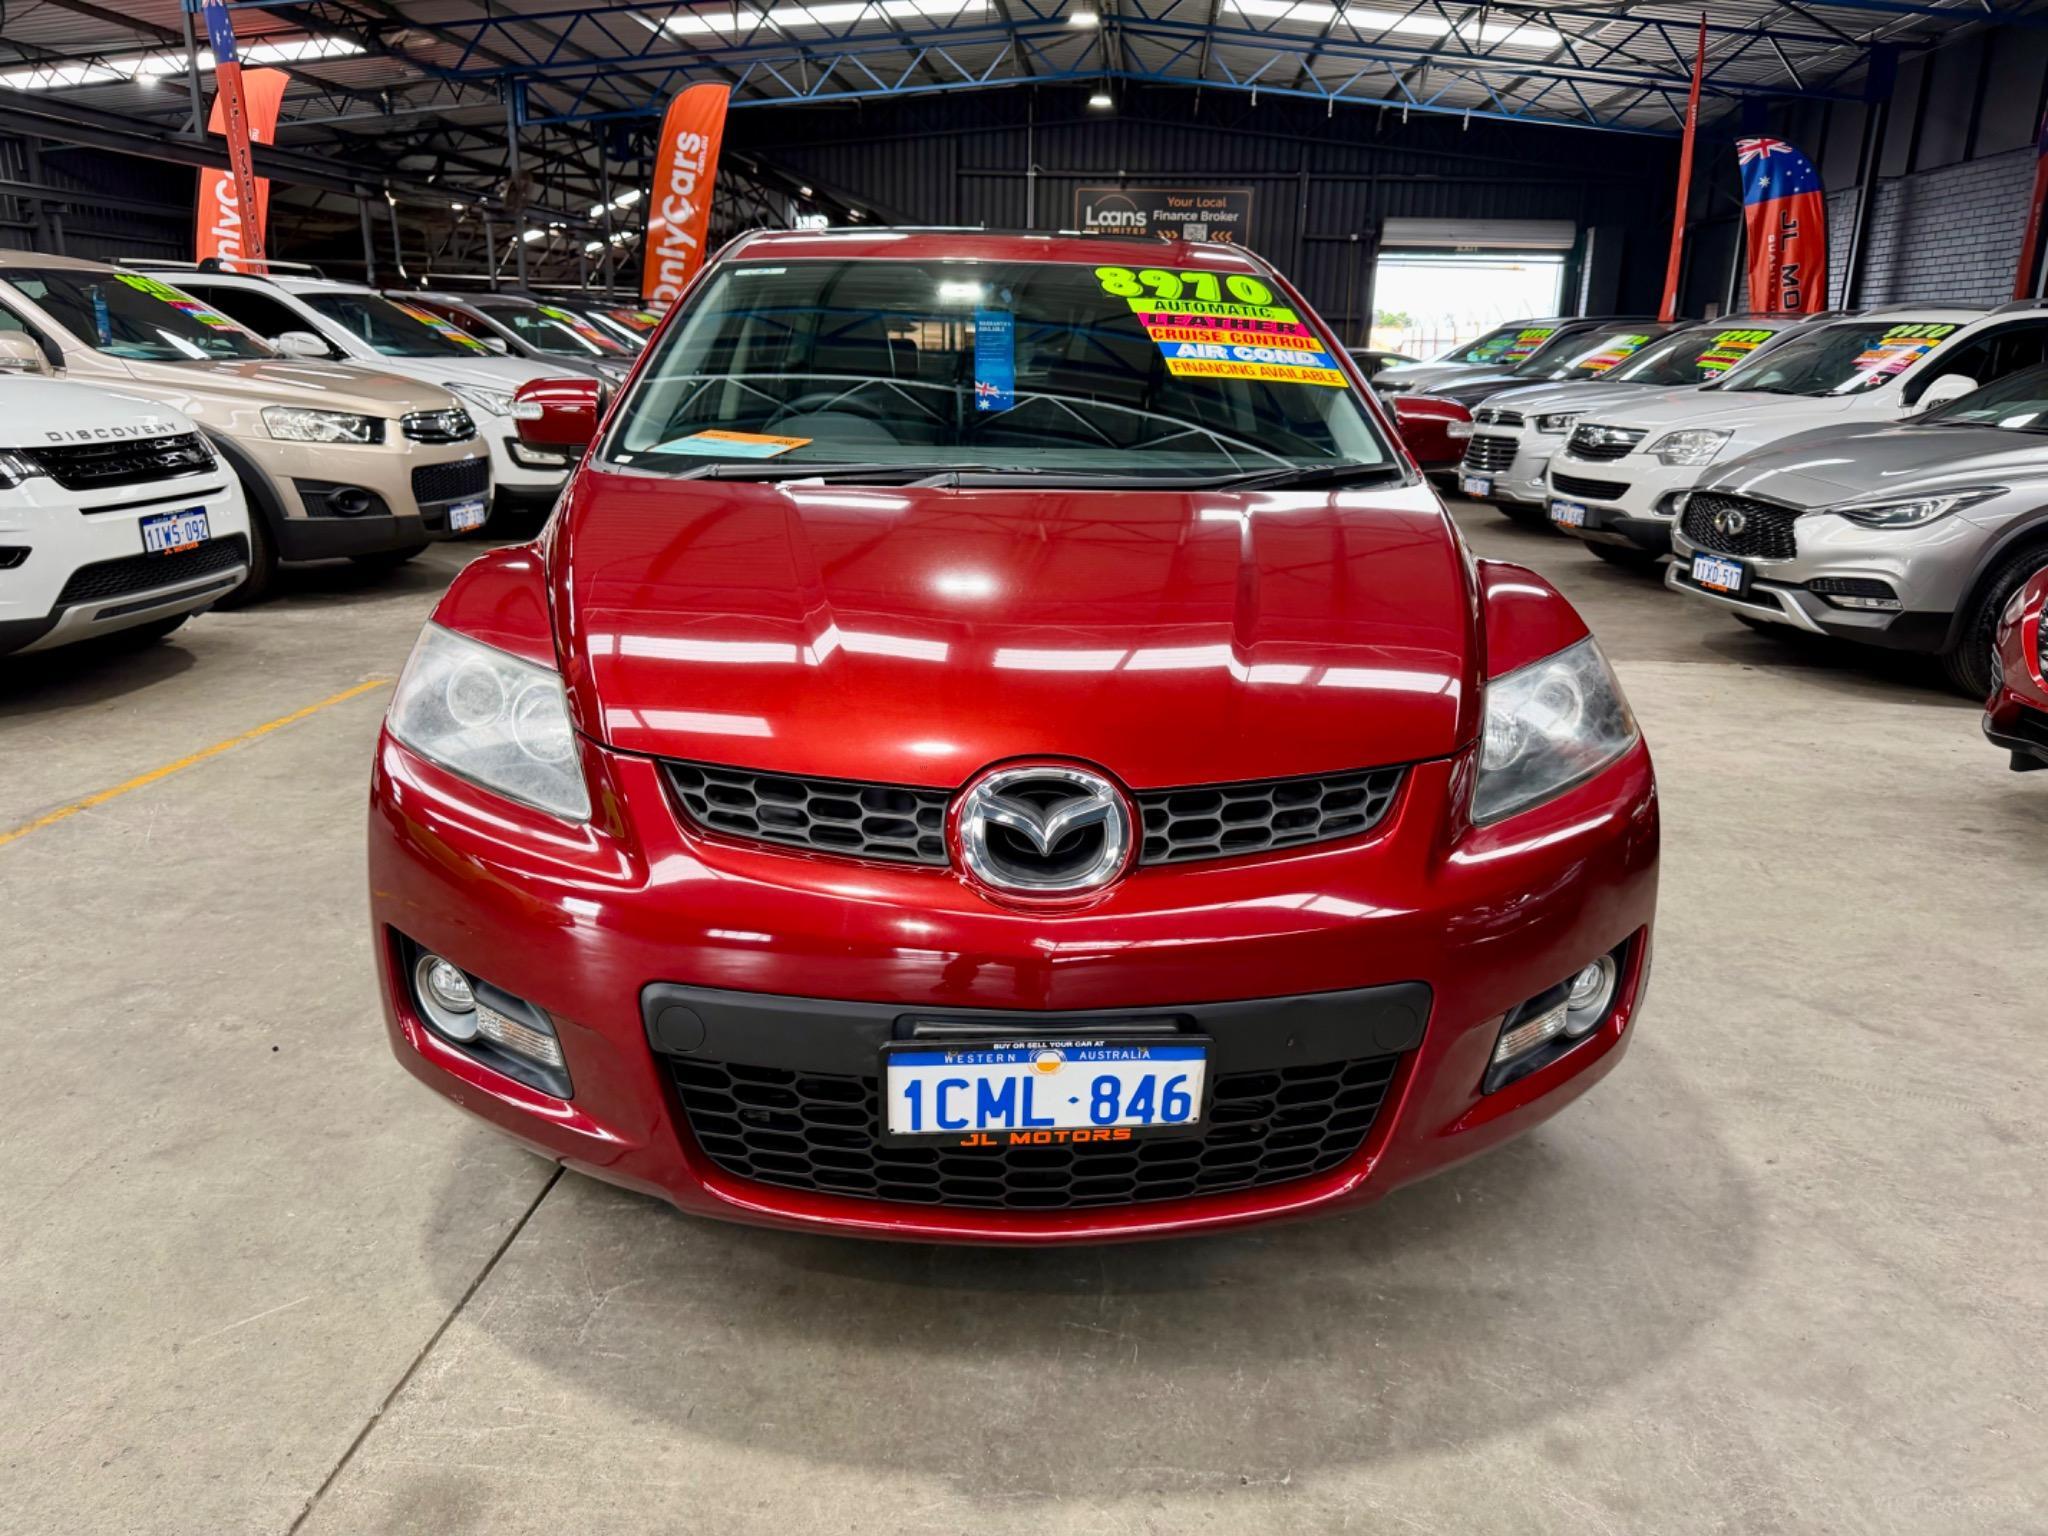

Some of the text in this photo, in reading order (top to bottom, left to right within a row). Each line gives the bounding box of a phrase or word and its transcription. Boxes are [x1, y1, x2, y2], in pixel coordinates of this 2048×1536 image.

[1167, 196, 1228, 208] Your Local
[650, 131, 701, 318] OnlyCars
[1086, 206, 1147, 226] Loans
[1152, 210, 1239, 222] Finance Broker
[1781, 211, 1799, 252] JL
[1095, 266, 1273, 305] 8970
[1153, 300, 1273, 319] AUTOMATIC
[1148, 313, 1298, 334] LEATHER
[1151, 328, 1317, 351] CRUISE CONTROL
[1176, 343, 1325, 367] AIR COND.
[1173, 357, 1339, 384] FINANCING AVAILABLE
[45, 422, 178, 443] DISCOVERY
[944, 1049, 1151, 1064] WESTERN AUSTRALIA
[960, 1128, 1133, 1147] JL MOTORS
